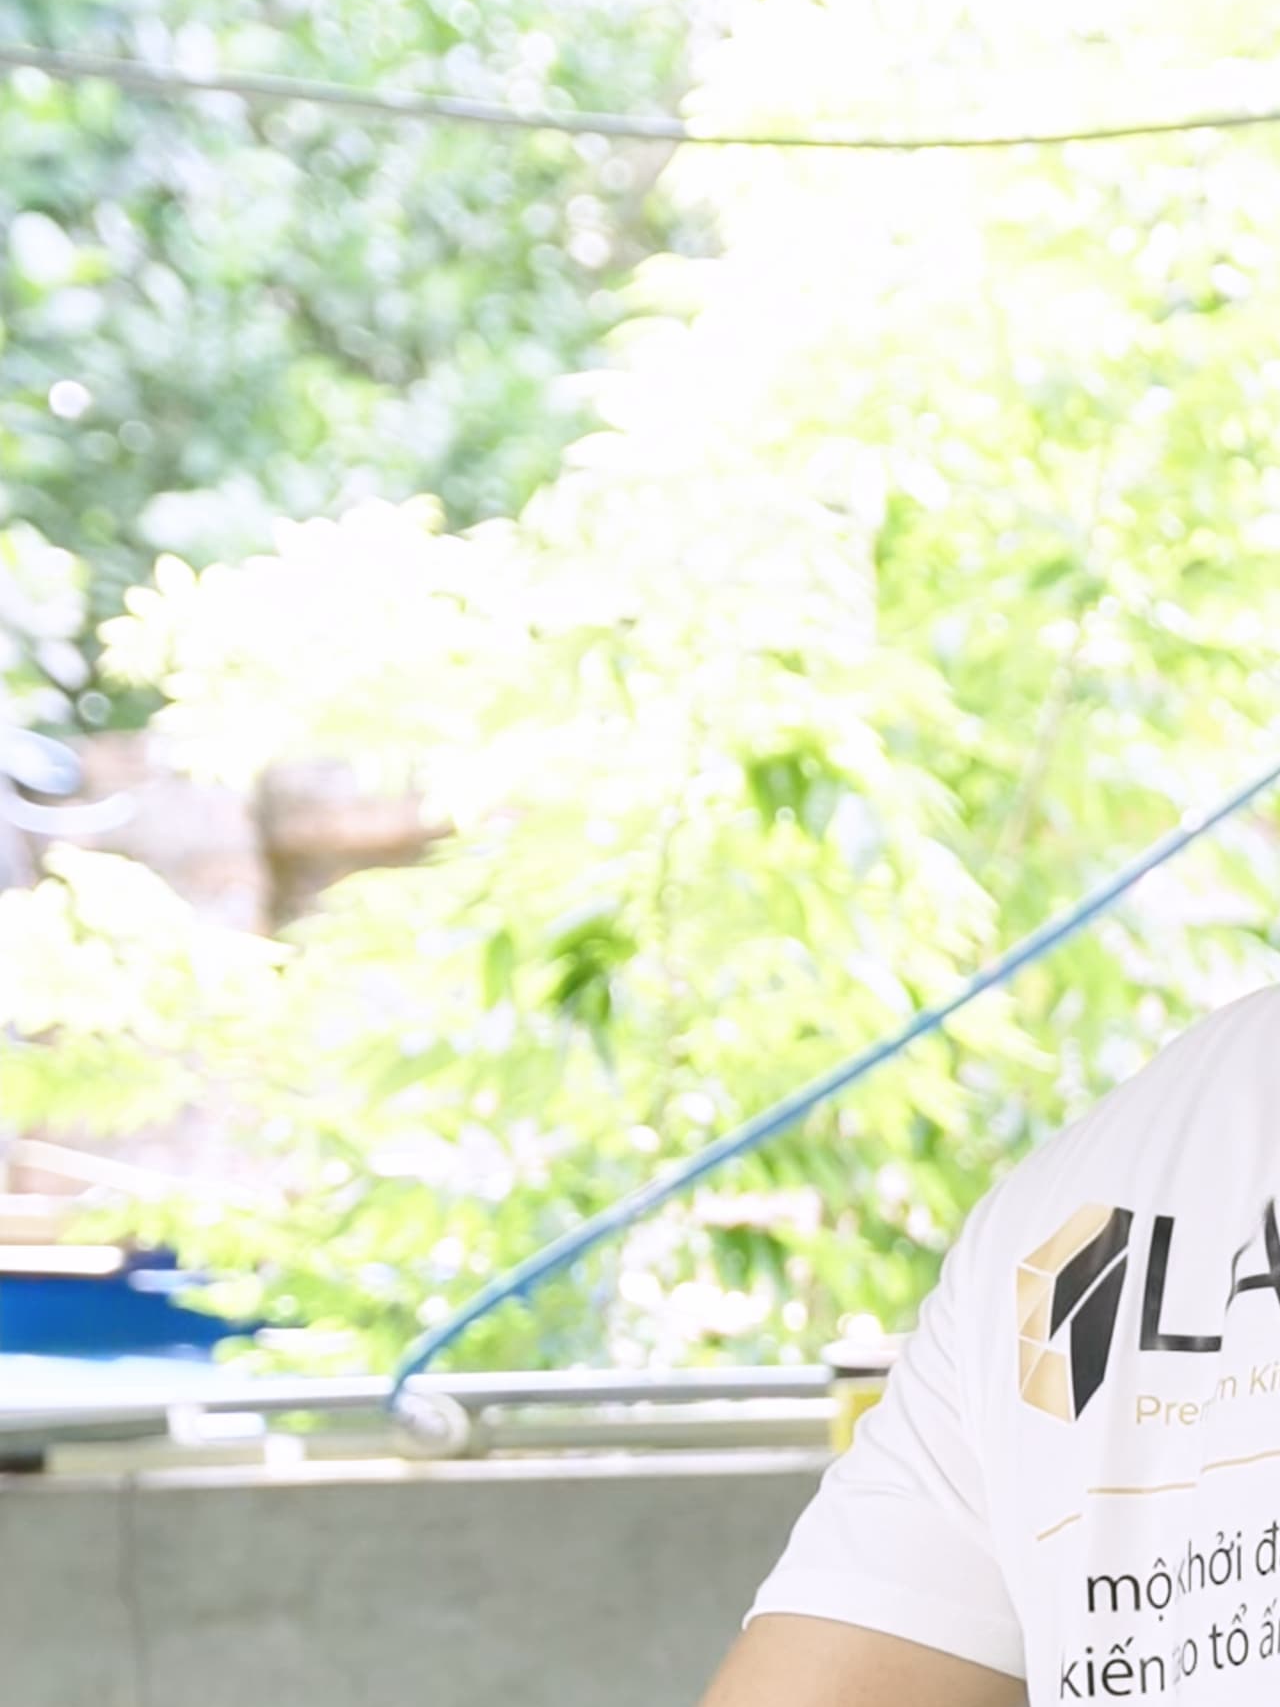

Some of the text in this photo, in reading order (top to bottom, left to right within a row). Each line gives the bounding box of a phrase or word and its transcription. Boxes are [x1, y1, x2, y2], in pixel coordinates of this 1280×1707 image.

[1086, 1556, 1173, 1622] mộ
[1060, 1636, 1166, 1700] kiến
[1208, 1602, 1250, 1670] tổ
